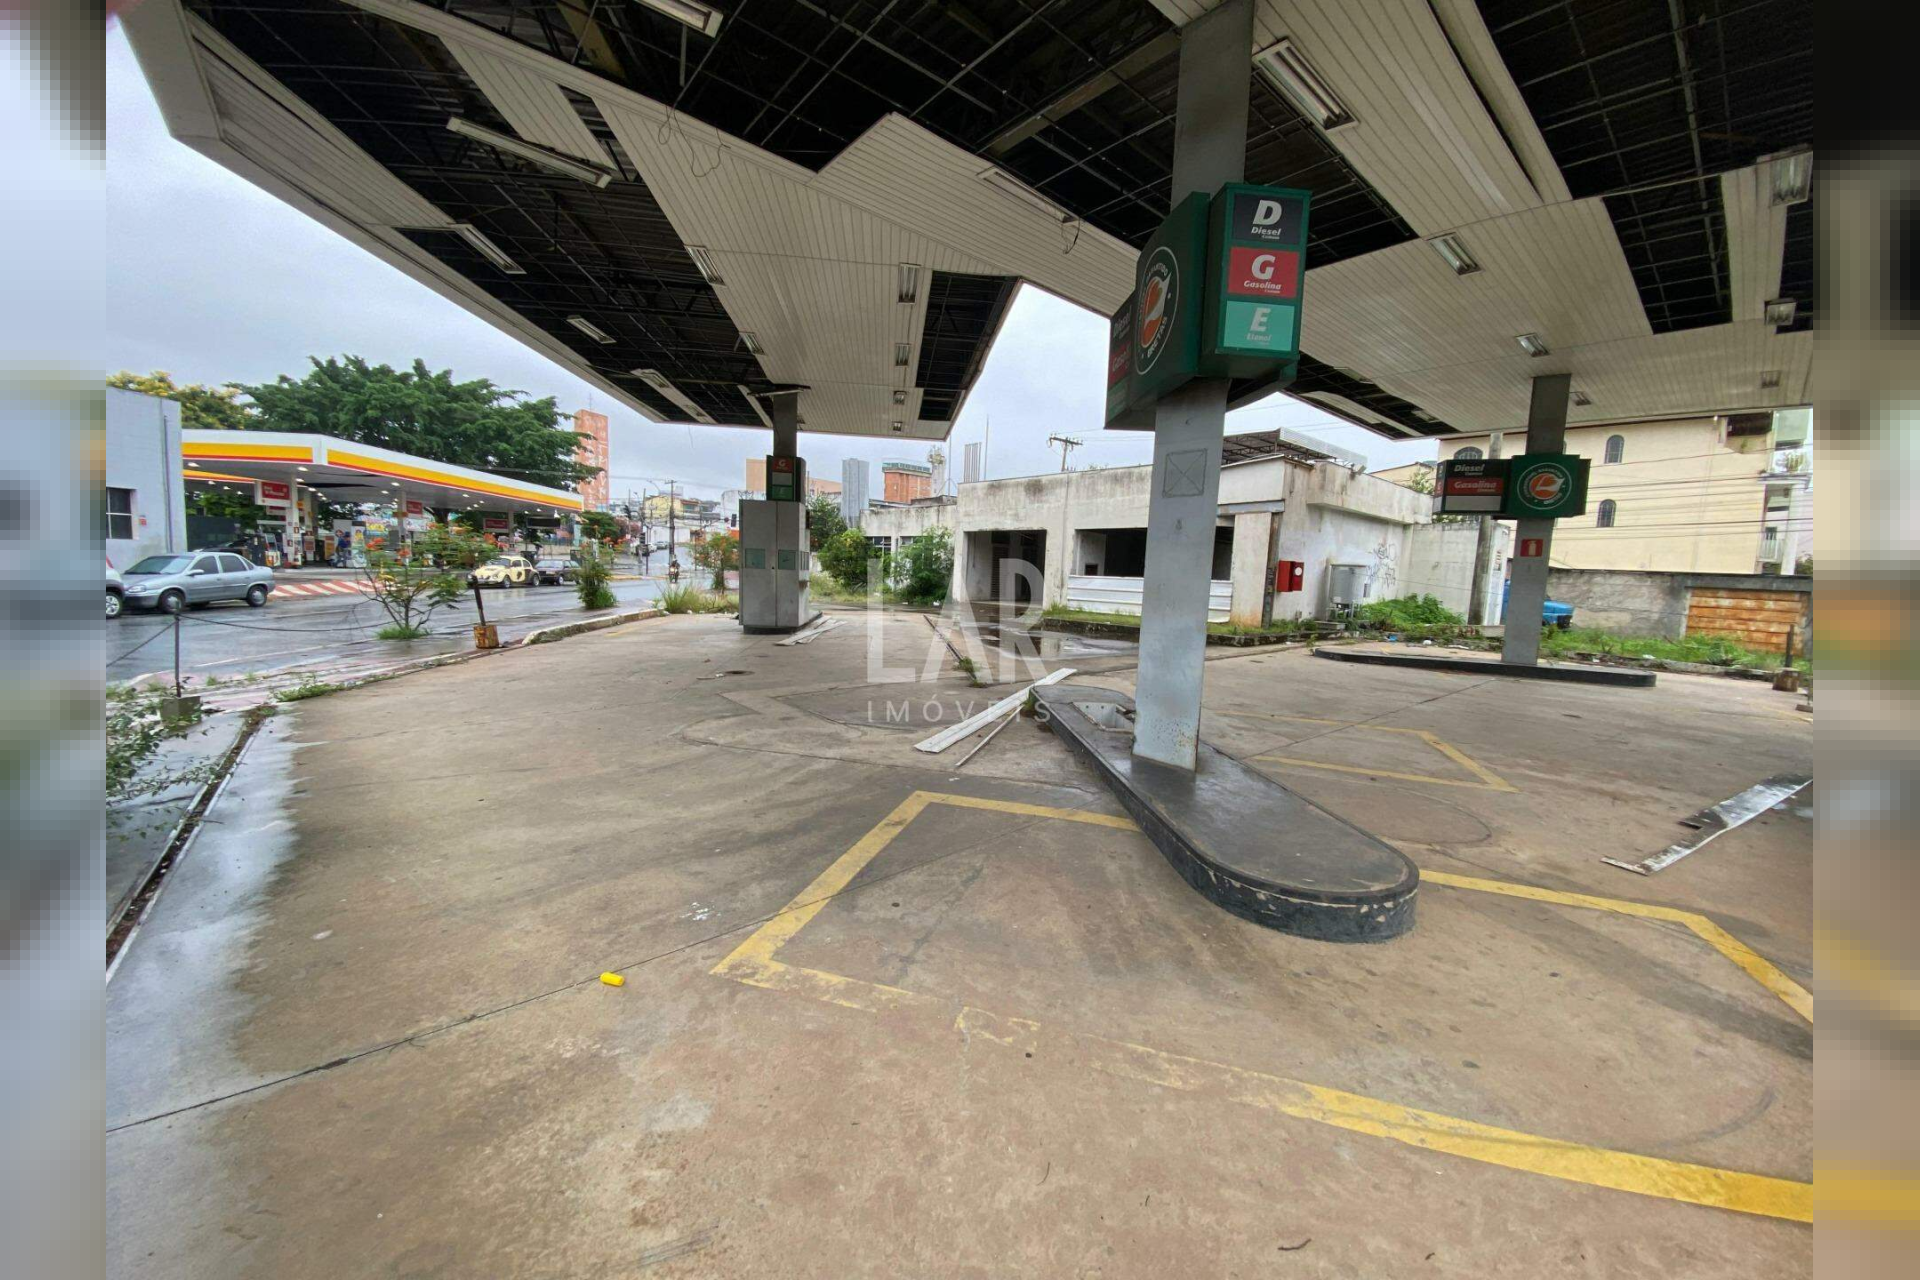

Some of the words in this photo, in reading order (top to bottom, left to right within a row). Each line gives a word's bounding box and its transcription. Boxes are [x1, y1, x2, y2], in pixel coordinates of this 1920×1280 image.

[1252, 199, 1283, 226] D
[1251, 226, 1282, 236] Diesel
[1251, 254, 1276, 280] G
[1243, 280, 1282, 290] Gasolina
[1250, 307, 1271, 332] E
[1453, 464, 1486, 472] Diesel
[1454, 480, 1497, 489] Gasolina
